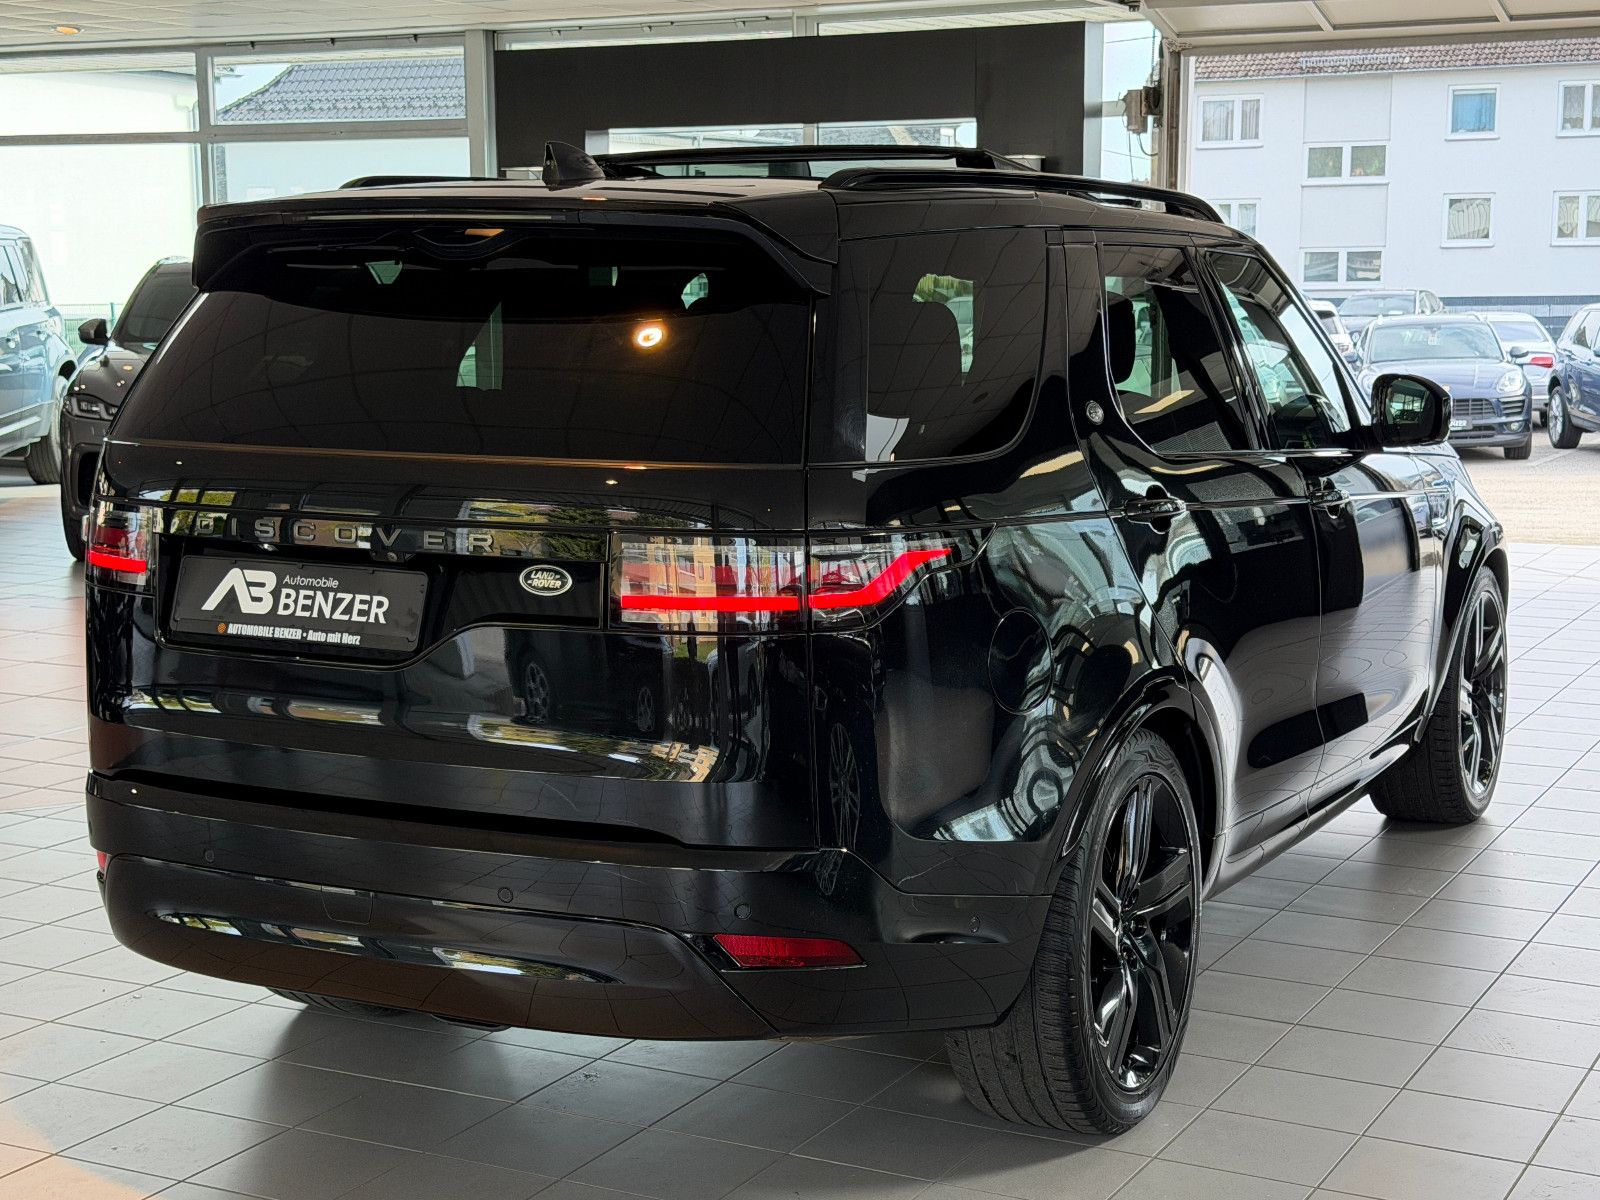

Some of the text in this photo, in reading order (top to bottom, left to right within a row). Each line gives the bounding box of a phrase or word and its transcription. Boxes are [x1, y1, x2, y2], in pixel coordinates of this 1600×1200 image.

[283, 574, 339, 588] Automobile
[531, 570, 556, 580] LAND
[532, 579, 562, 589] ROVER
[201, 567, 277, 615] AB
[276, 588, 390, 624] BENZER
[227, 623, 361, 646] AUTOMOBILE BENZER Auto mit Herz
